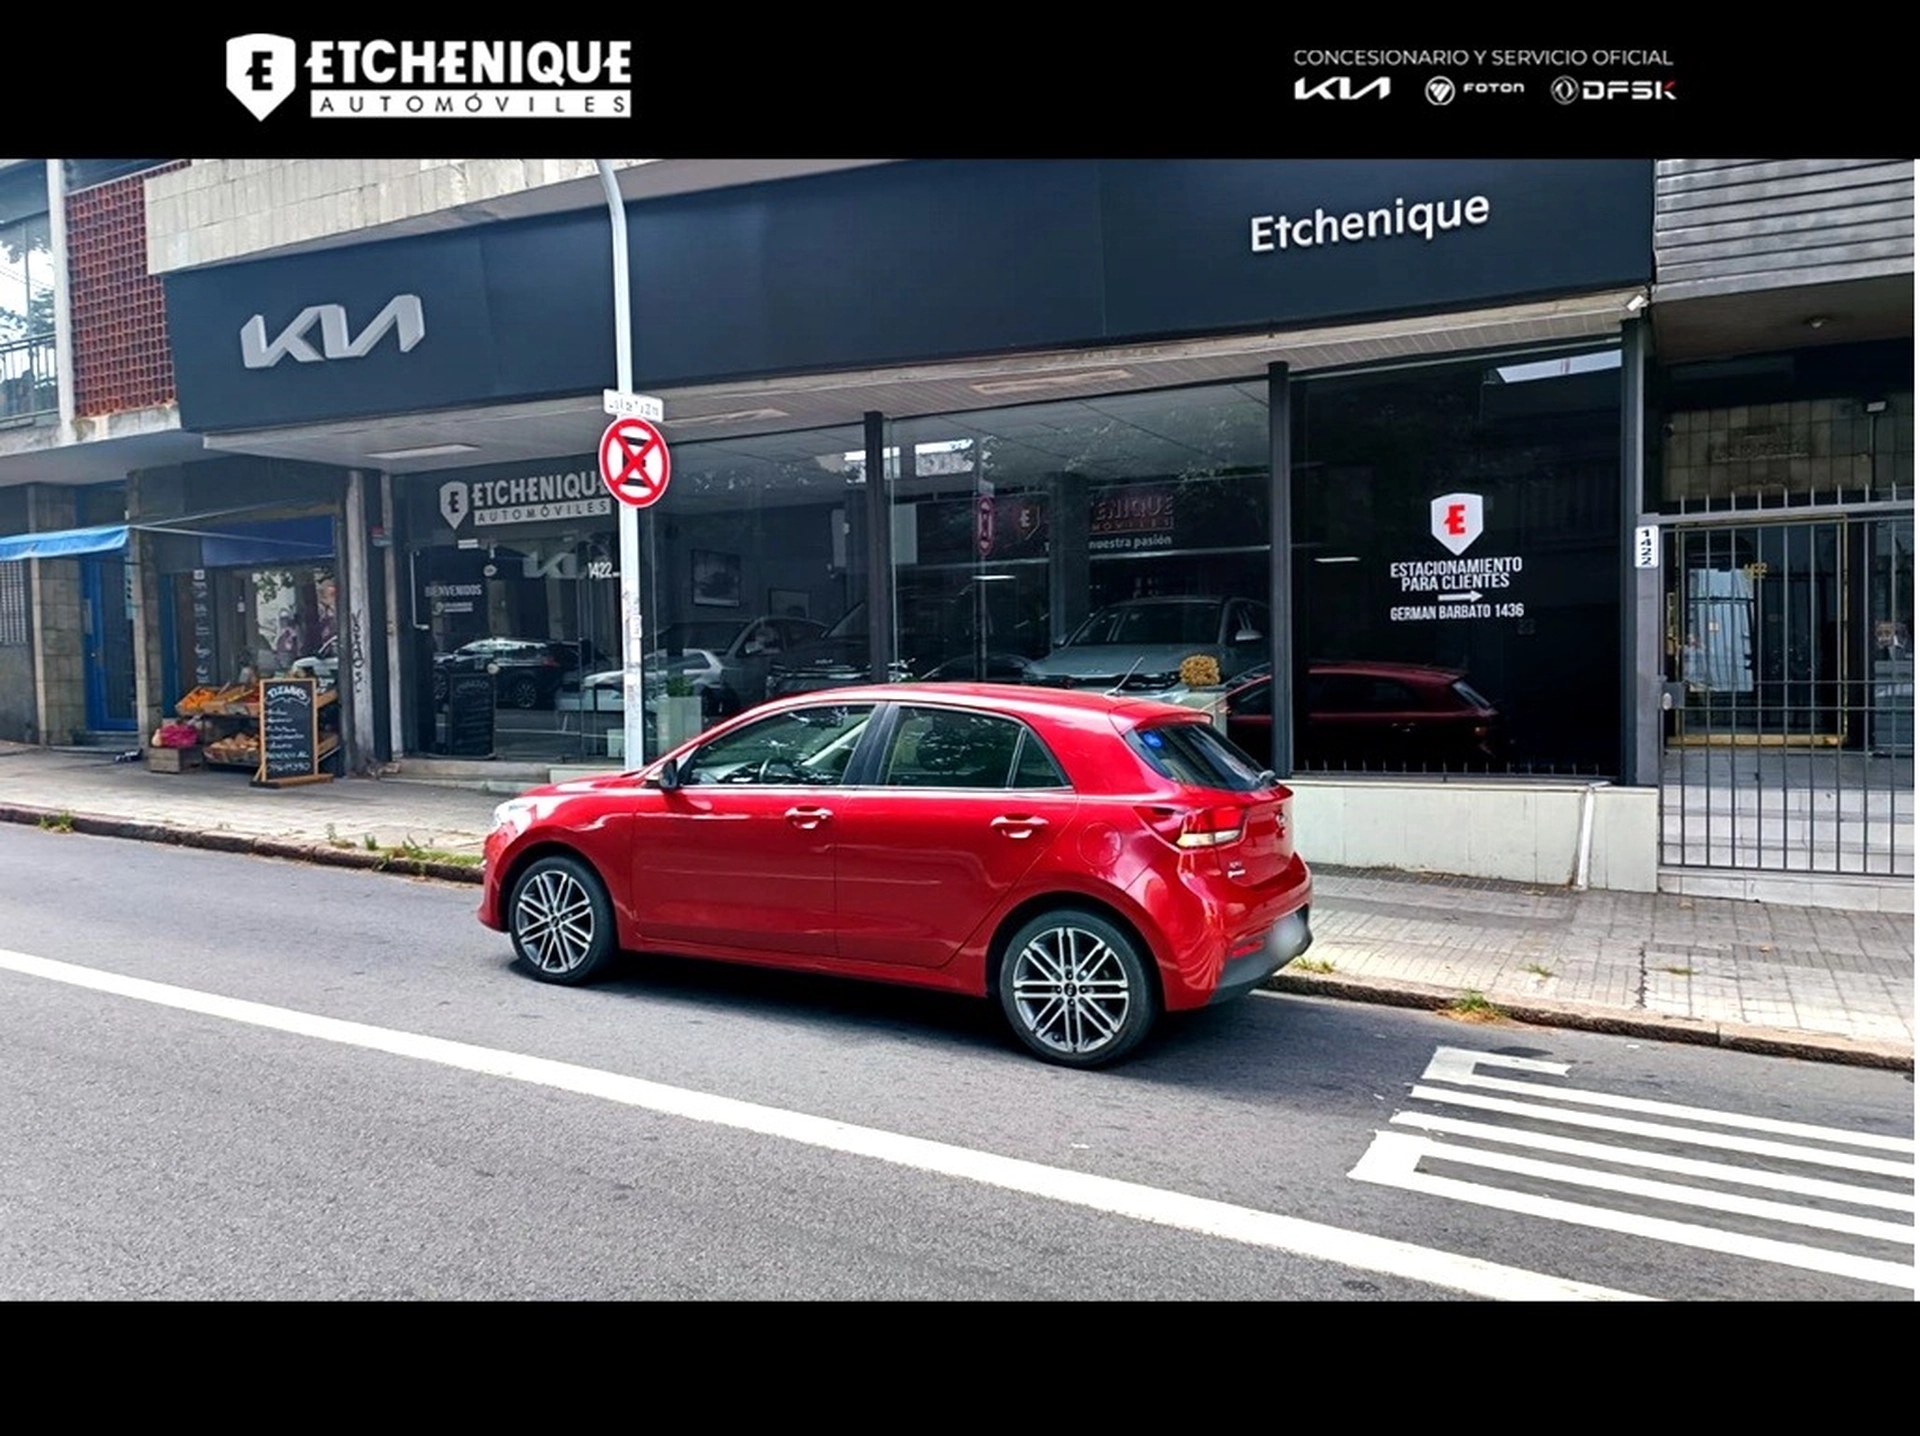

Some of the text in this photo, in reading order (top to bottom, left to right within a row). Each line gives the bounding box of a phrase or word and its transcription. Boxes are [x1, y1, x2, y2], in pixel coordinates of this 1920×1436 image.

[1250, 194, 1490, 252] Etchenique
[240, 294, 425, 369] KIA
[477, 501, 607, 522] AUTOMÓVILES
[1088, 533, 1172, 550] nuestra pasión
[1640, 528, 1652, 566] 1422
[587, 562, 613, 579] 1422
[1390, 556, 1523, 578] ESTACIONAMIENTO
[1401, 573, 1510, 592] PARA CLIENTES
[1390, 603, 1524, 621] GERMAN BARBATO 1436
